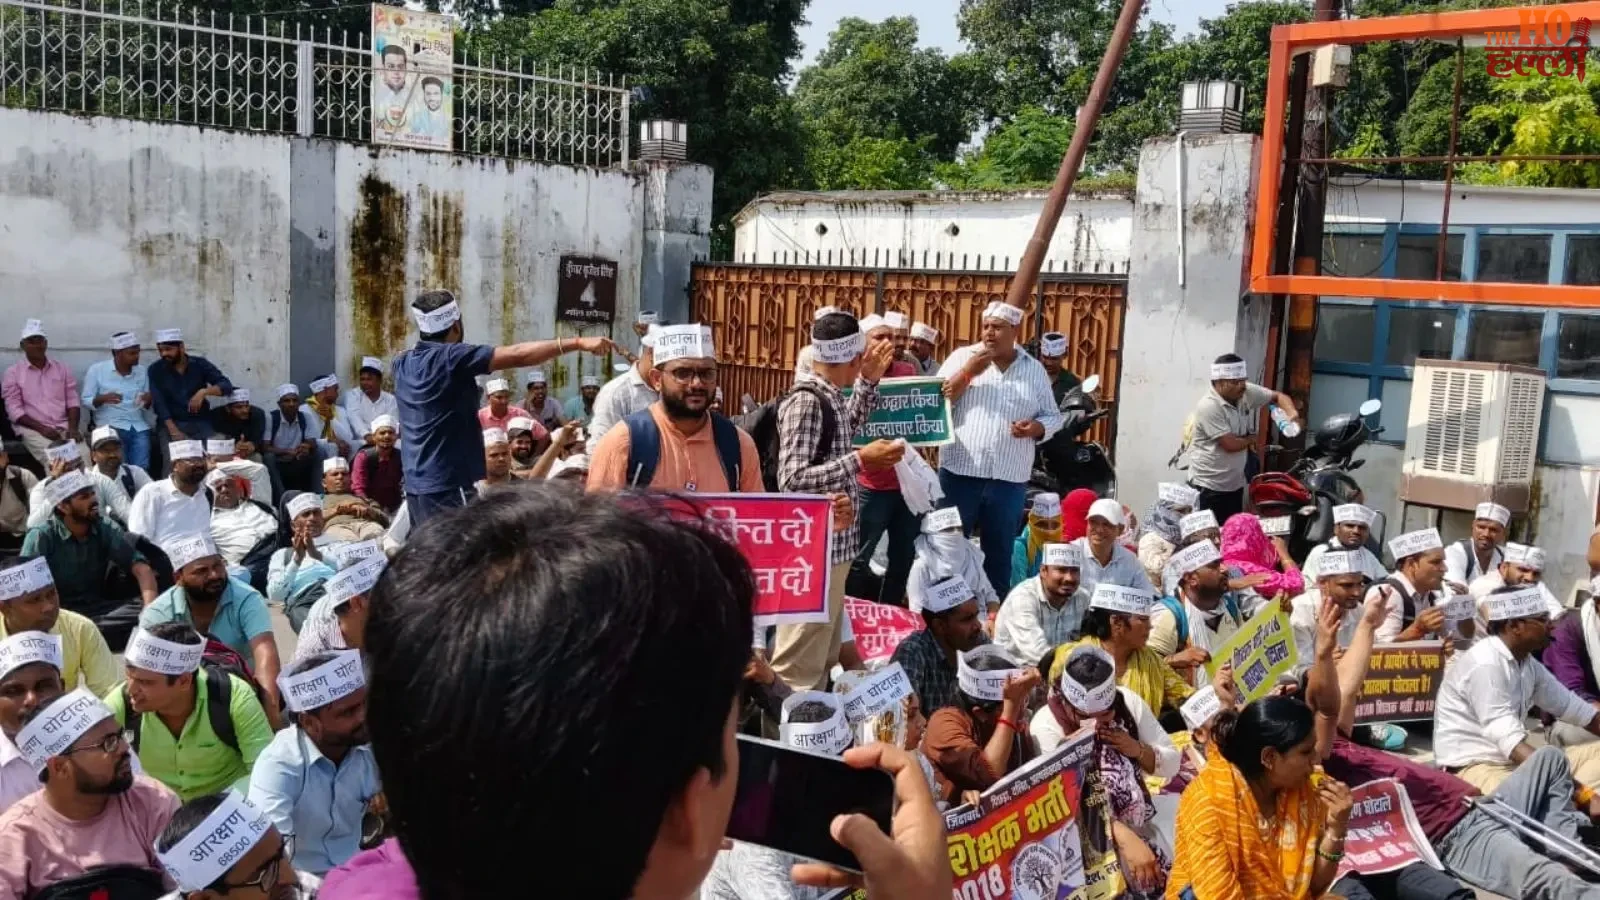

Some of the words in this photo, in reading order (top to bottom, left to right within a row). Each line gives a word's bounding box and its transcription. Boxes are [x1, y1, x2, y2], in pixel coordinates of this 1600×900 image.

[880, 394, 909, 412] उद्धार
[910, 388, 939, 410] किया
[865, 419, 914, 438] अत्याचार
[914, 414, 945, 436] किया
[778, 507, 814, 548] दो
[780, 557, 814, 596] दो
[42, 696, 94, 735] घोटाला
[795, 727, 837, 747] आरक्षण
[1024, 773, 1072, 835] भर्ती
[189, 808, 246, 862] आरक्षण
[218, 836, 251, 867] 68500
